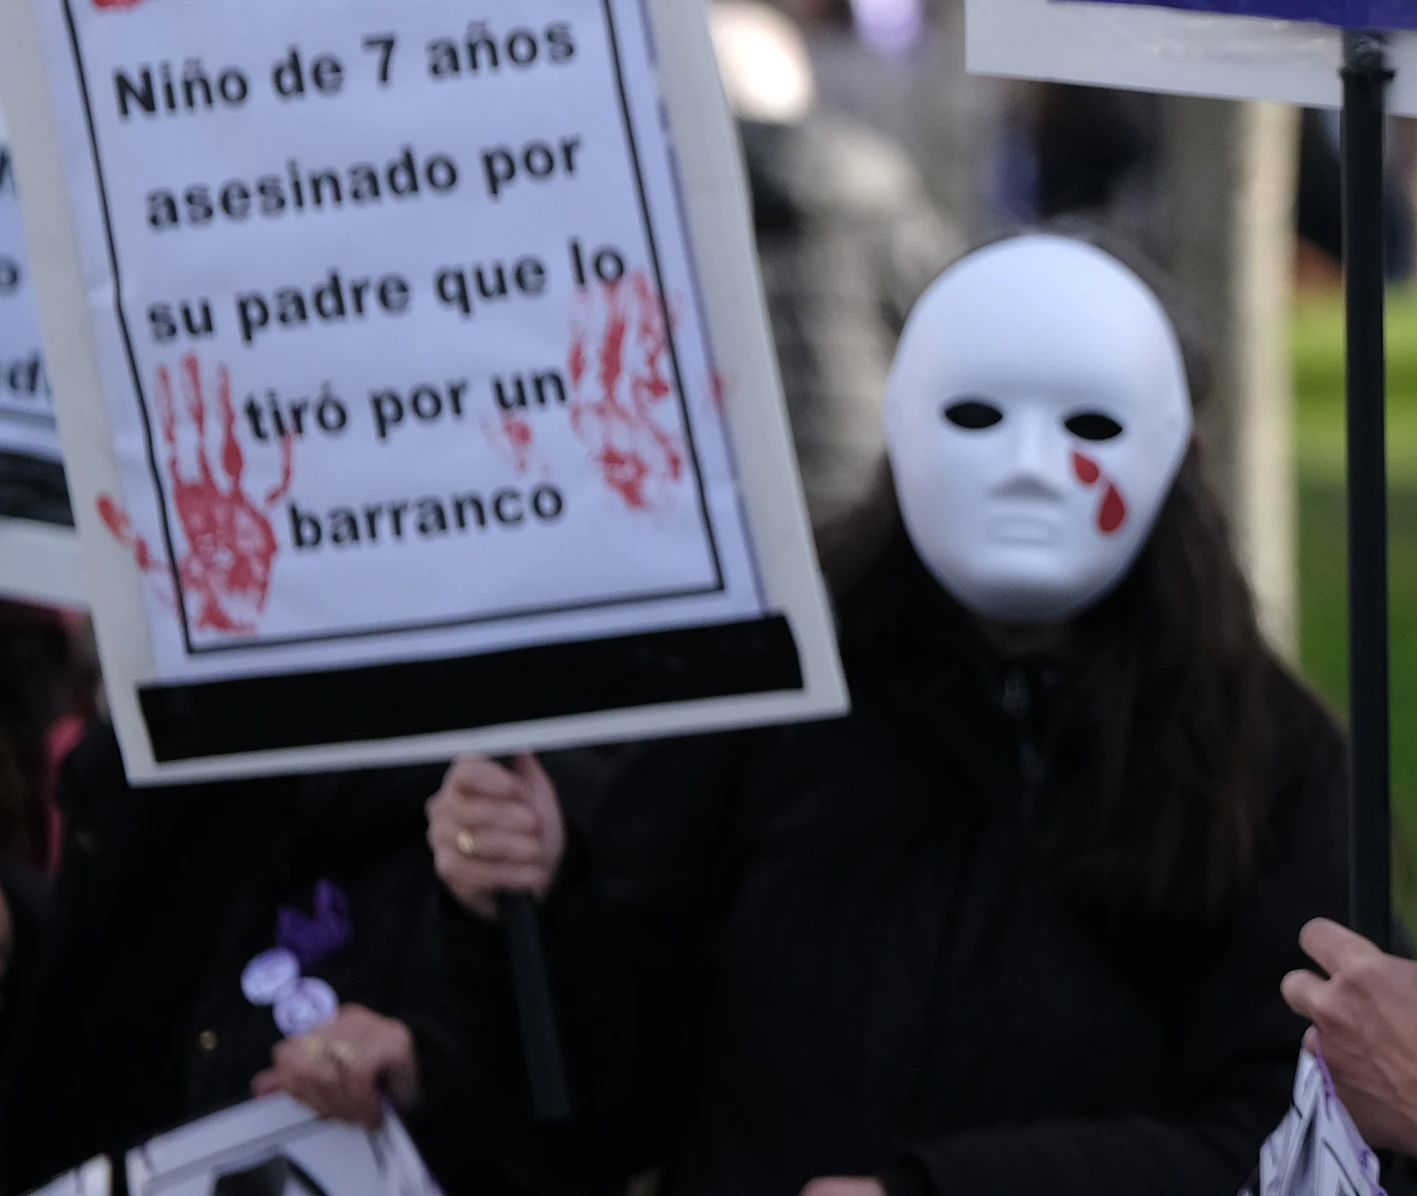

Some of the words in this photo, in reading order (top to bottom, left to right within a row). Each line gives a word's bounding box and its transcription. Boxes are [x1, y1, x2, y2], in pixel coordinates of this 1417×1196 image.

[113, 57, 249, 117] Niño
[271, 45, 343, 98] de
[363, 35, 397, 85] 7
[430, 21, 577, 78] años
[146, 145, 460, 229] asesinado
[482, 135, 582, 198] por
[147, 300, 215, 340] su
[235, 266, 412, 345] padre
[435, 259, 547, 317] que
[569, 236, 627, 290] lo
[243, 379, 349, 443] tiró
[370, 380, 469, 441] por
[493, 370, 568, 413] un
[287, 483, 565, 551] barranco
